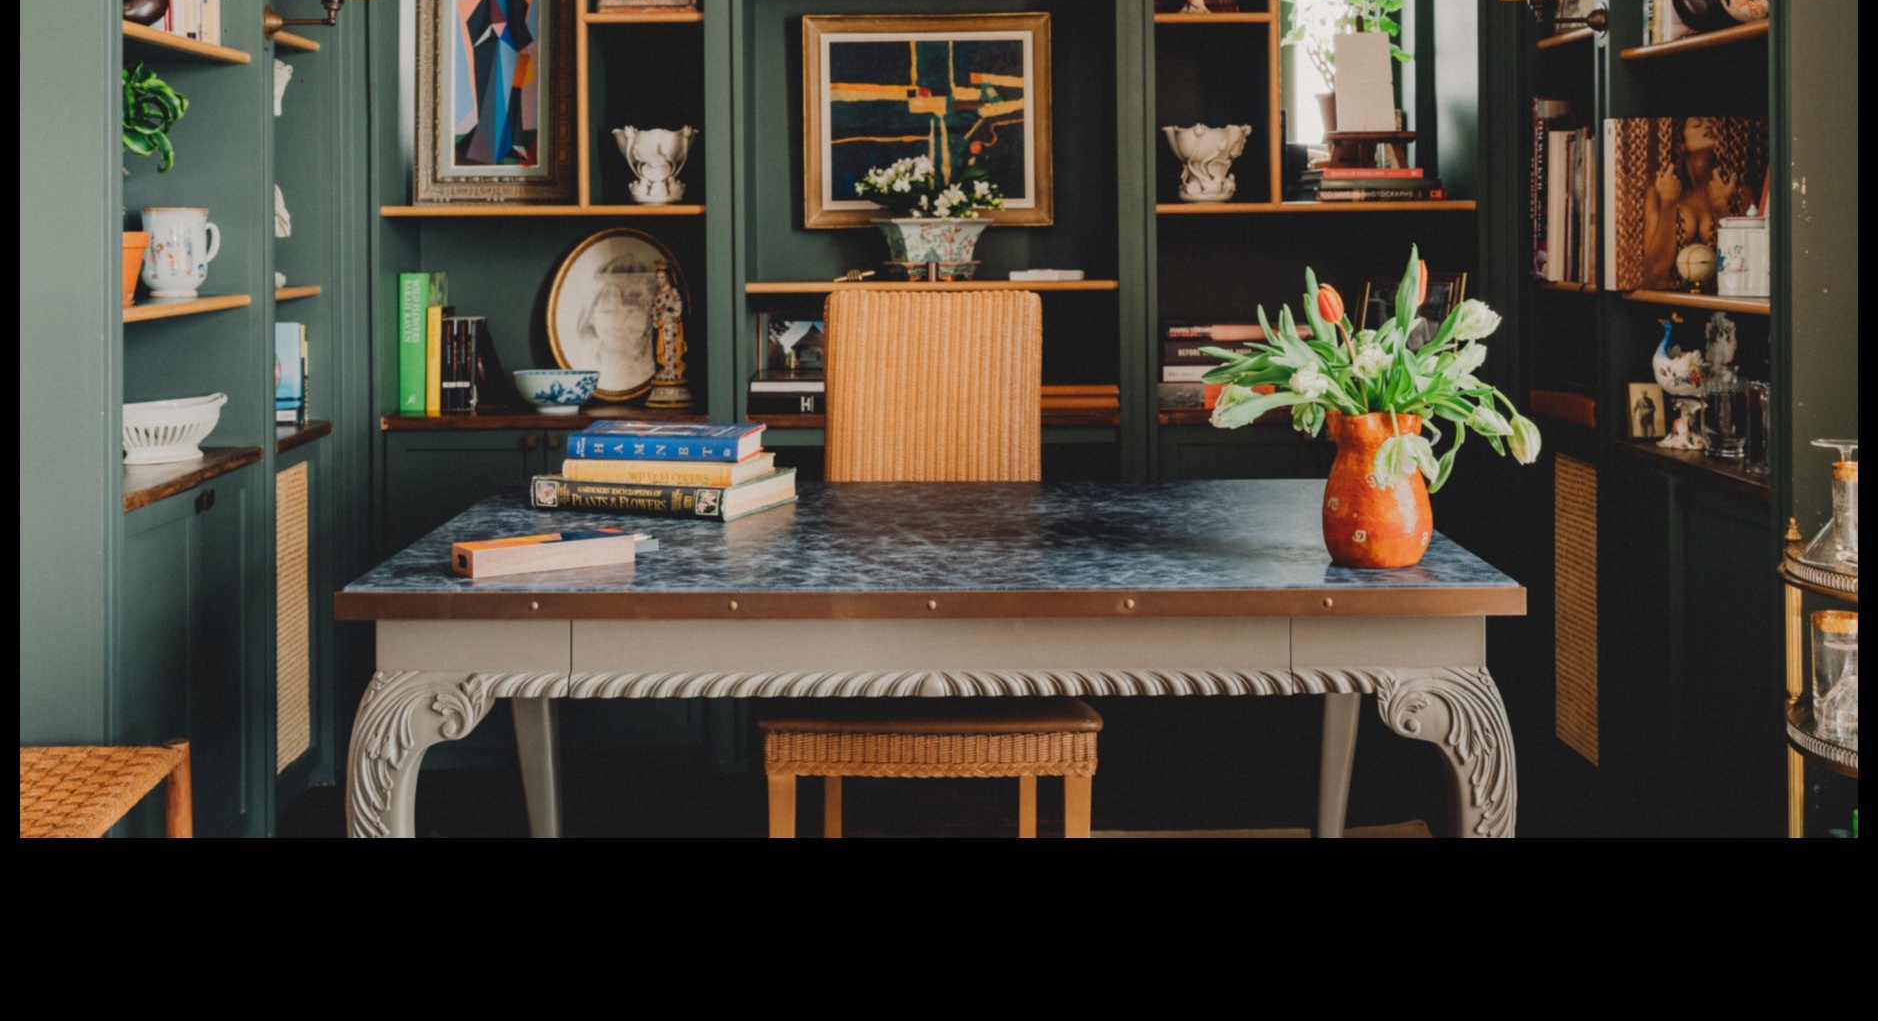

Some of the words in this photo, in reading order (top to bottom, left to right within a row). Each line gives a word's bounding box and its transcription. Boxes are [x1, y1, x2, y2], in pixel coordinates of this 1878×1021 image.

[1362, 190, 1413, 198] PHOTOGRAPHS
[403, 279, 412, 311] SARAH
[411, 279, 420, 304] WILD
[403, 312, 412, 343] RAVEN
[411, 304, 420, 343] FLOWERS
[593, 441, 714, 457] HAMNET
[628, 471, 658, 482] WILD
[659, 472, 709, 484] FLOWERS
[571, 493, 609, 508] PLANTS
[610, 496, 618, 508] &
[619, 496, 667, 511] FLOWERS
